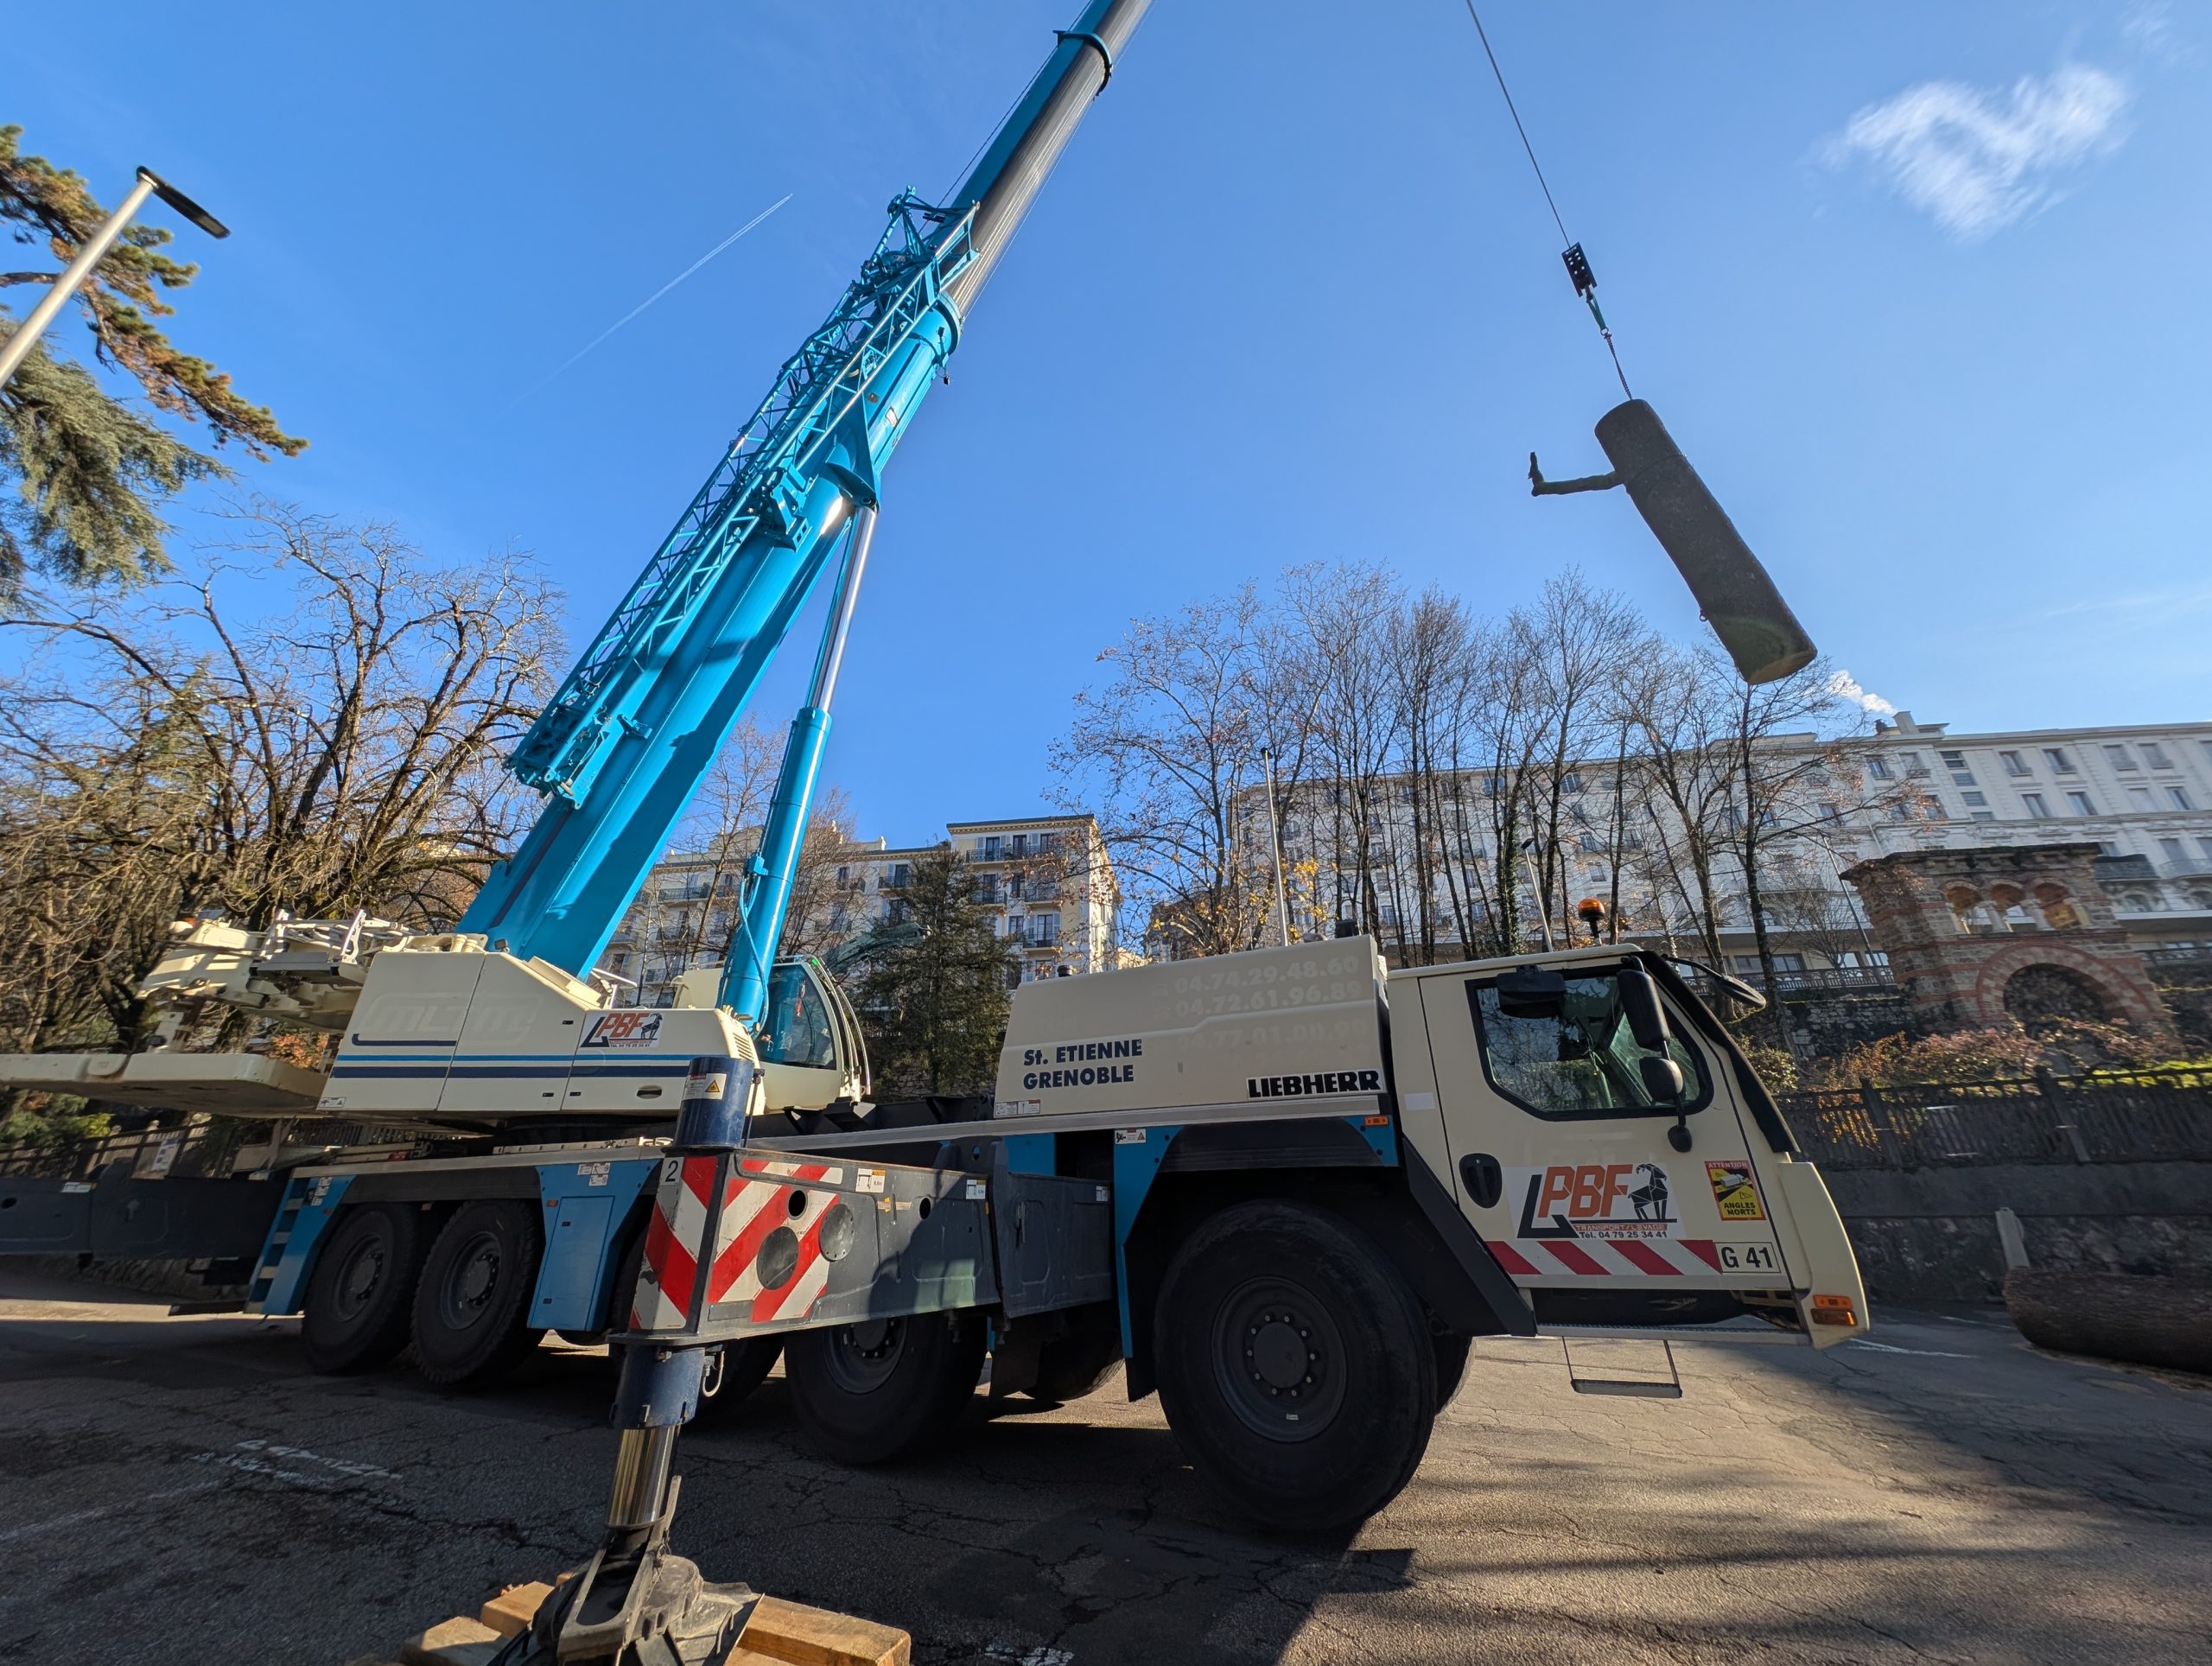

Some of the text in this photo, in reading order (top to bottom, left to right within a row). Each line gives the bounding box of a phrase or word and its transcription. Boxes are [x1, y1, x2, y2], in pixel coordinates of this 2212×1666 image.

[1175, 956, 1359, 994] 04.74.29.48.60
[1023, 1039, 1142, 1065] St. ETIENNE
[1023, 1065, 1135, 1090] GRENOBLE
[1248, 1070, 1381, 1097] LIEBHERR
[664, 1160, 679, 1182] 2
[1720, 1246, 1773, 1269] G 41
